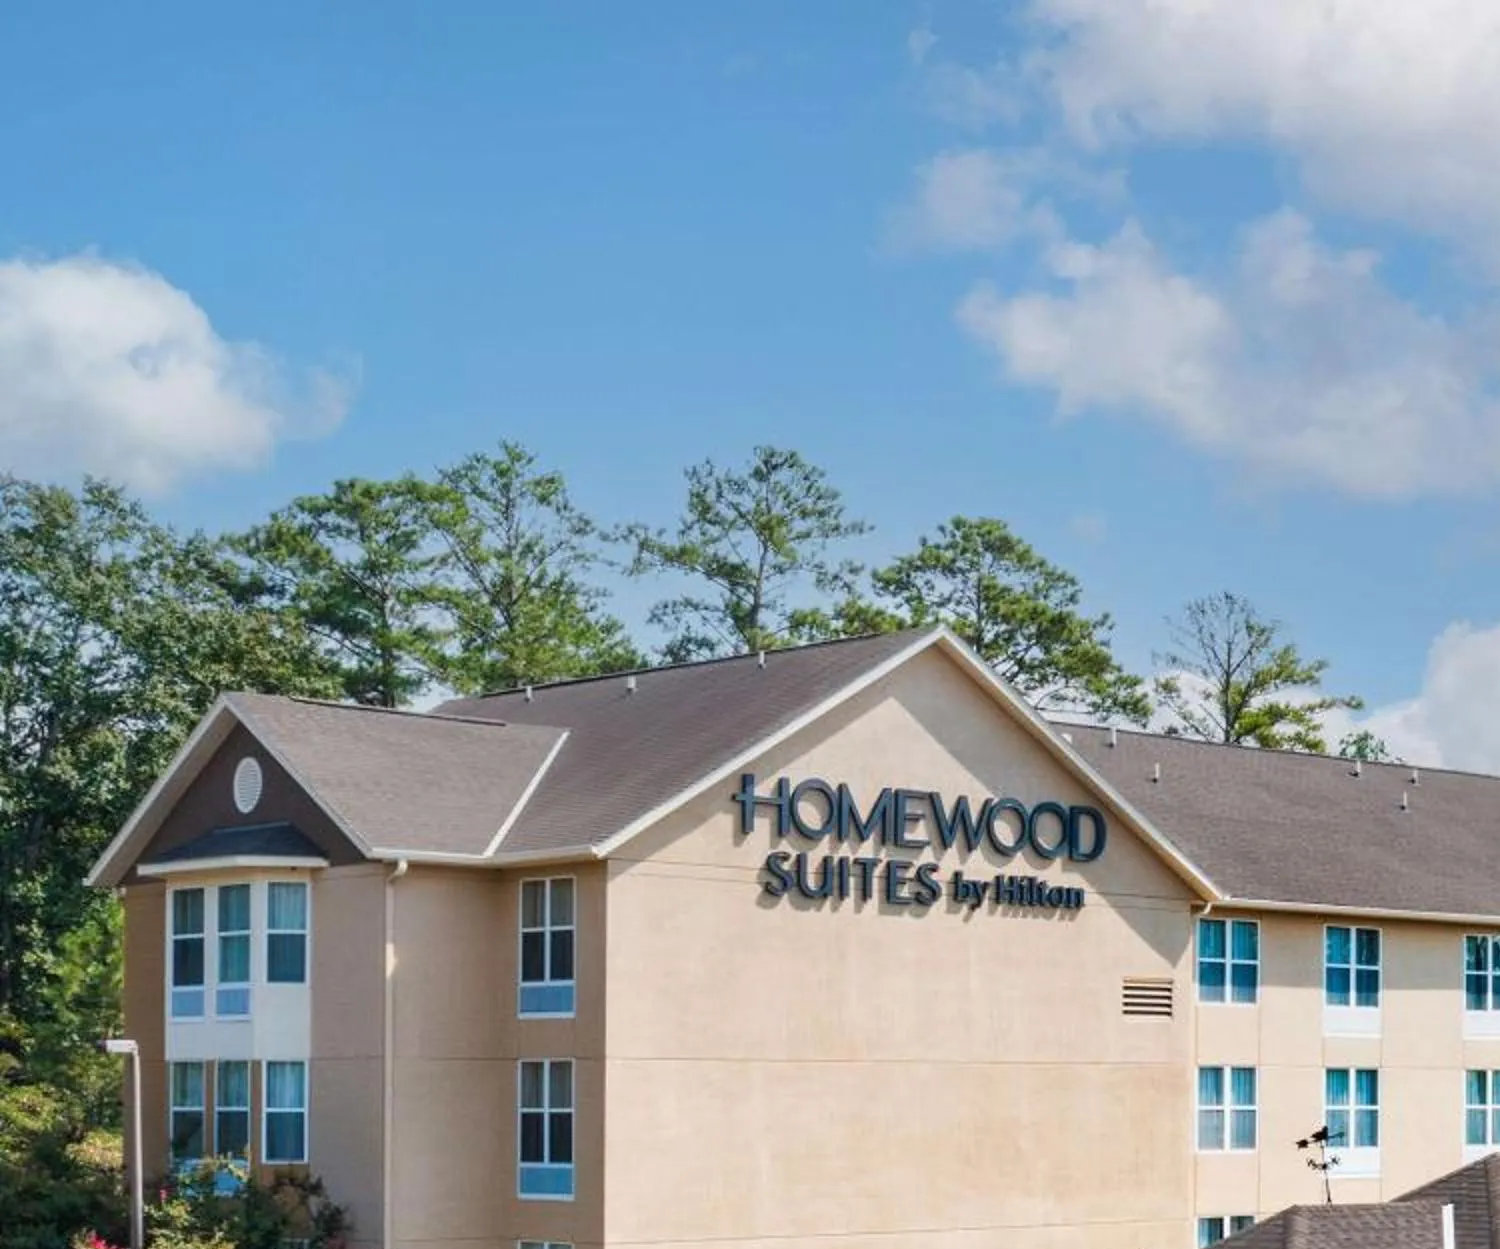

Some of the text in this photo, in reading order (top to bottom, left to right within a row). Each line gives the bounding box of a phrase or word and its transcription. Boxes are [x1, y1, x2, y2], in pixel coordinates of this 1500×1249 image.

[731, 773, 1107, 863] HOMEWOOD
[763, 851, 1085, 911] SUITES by Hilton
